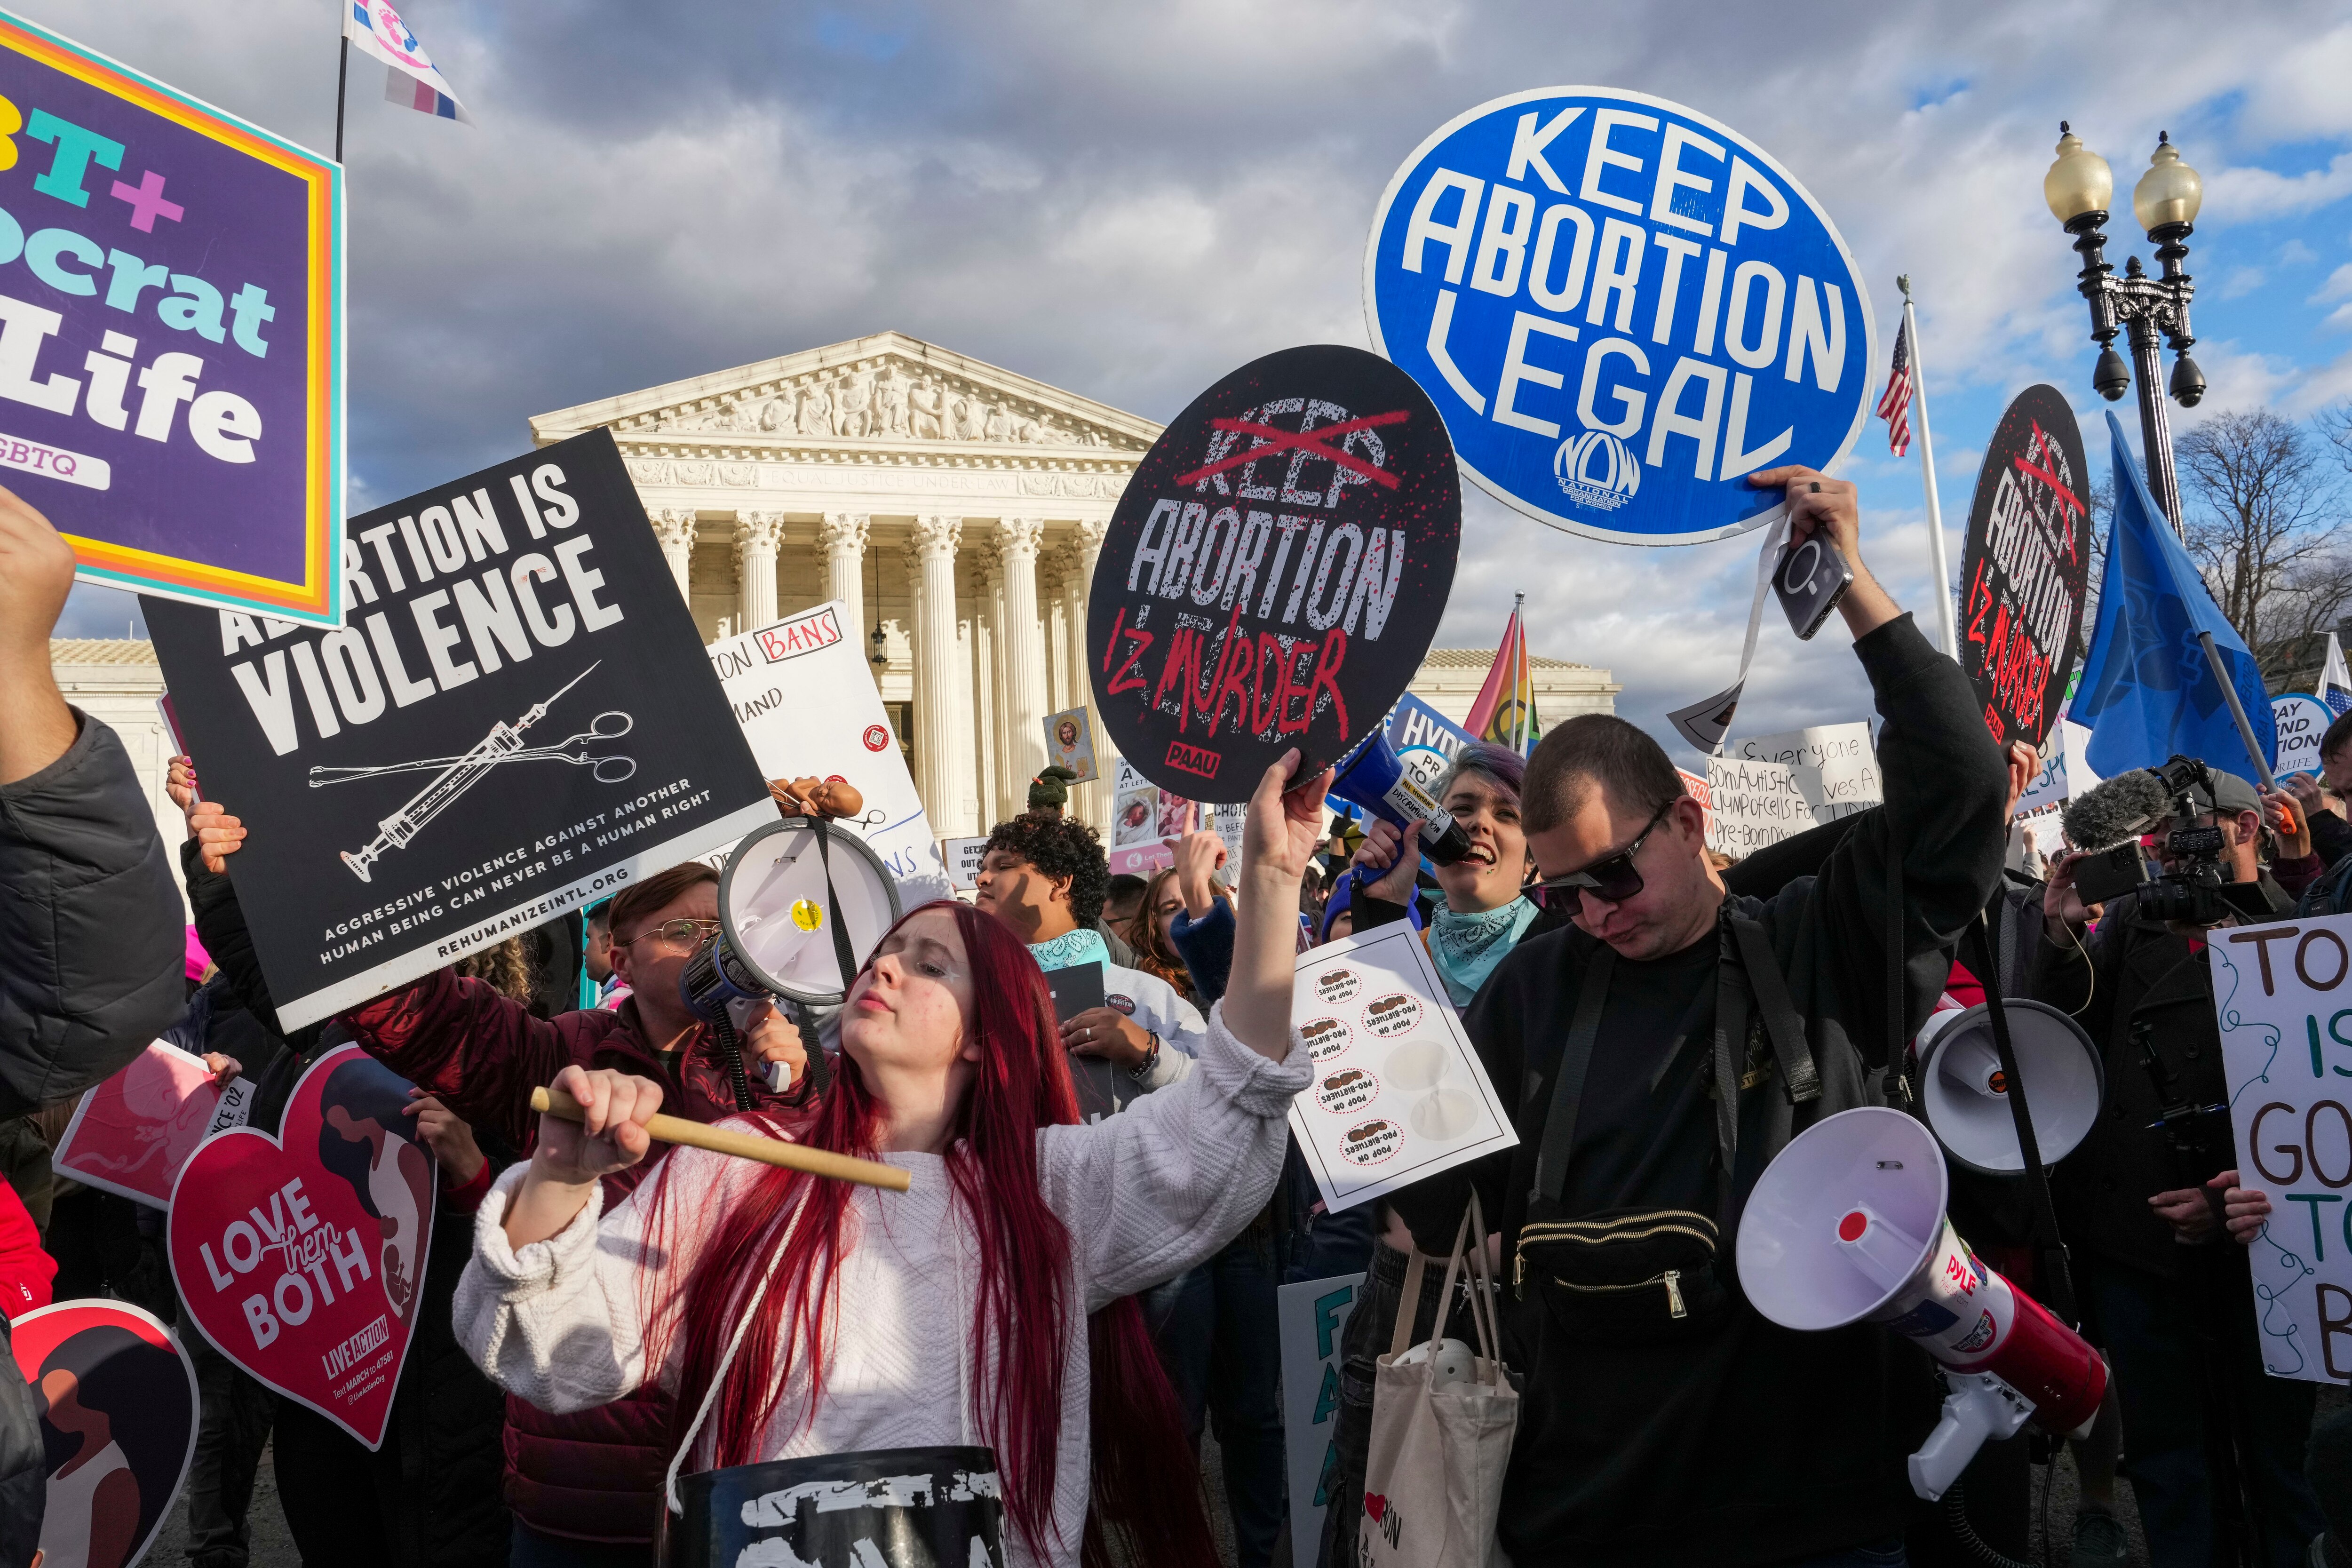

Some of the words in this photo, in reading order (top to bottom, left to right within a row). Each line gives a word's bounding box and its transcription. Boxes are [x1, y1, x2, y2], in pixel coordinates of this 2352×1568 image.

[1506, 107, 1789, 246] KEEP
[1401, 167, 1845, 393] ABORTION
[1426, 288, 1794, 482] LEGAL
[1196, 398, 1385, 508] KEEP
[1554, 431, 1640, 496] NOW
[772, 471, 833, 485] EQUAL
[841, 473, 904, 487] JUSTICE
[914, 475, 969, 489] UNDER
[977, 477, 1009, 490] LAW
[1558, 478, 1628, 502] NATIONAL
[2021, 431, 2077, 558] KEEP
[509, 463, 579, 540] IS
[1563, 487, 1621, 507] ORGANIZATION
[1585, 498, 1613, 509] WOMEN
[1128, 498, 1406, 640] ABORTION
[1986, 467, 2072, 676] ABORTION
[231, 533, 624, 756] VIOLENCE
[711, 642, 752, 682] ON
[762, 614, 836, 659] BANS
[1154, 603, 1348, 741] MURDER
[1985, 605, 2050, 742] MURDER
[1986, 708, 2004, 740] PAAU
[1168, 745, 1218, 774] PAAU
[1744, 740, 1859, 769] Everyone
[1121, 768, 1132, 781] A
[1409, 762, 1427, 784] TO
[1862, 768, 1875, 790] A
[1404, 791, 1418, 804] ANYTHING
[1796, 801, 1820, 819] For
[326, 886, 435, 940] AGGRESSIVE
[442, 848, 527, 890] VIOLENCE
[535, 813, 605, 852] AGAINST
[615, 779, 691, 819] ANOTHER
[961, 859, 975, 868] OUT
[320, 930, 384, 964] HUMAN
[390, 905, 443, 935] BEING
[450, 887, 485, 909] CAN
[491, 861, 547, 892] NEVER
[552, 850, 573, 866] BE
[582, 843, 591, 854] A
[596, 814, 657, 846] HUMAN
[661, 789, 710, 819] RIGHT
[437, 868, 628, 958] REHUMANIZEINTL.ORG
[2228, 926, 2349, 996] TO
[1110, 998, 1133, 1008] ABORTION
[1339, 989, 1352, 998] POOP
[1378, 1027, 1389, 1035] ON
[1392, 1018, 1411, 1031] POOP
[1322, 1043, 1341, 1055] POOP
[224, 1087, 244, 1106] '02
[1334, 1103, 1344, 1112] ON
[1348, 1094, 1367, 1106] POOP
[1358, 1154, 1369, 1163] ON
[1372, 1145, 1391, 1158] POOP
[199, 1177, 319, 1293] LOVE
[260, 1222, 342, 1274] them
[242, 1227, 372, 1350] BOTH
[322, 1340, 354, 1380] LIVE
[353, 1317, 388, 1362] ACTION
[333, 1386, 346, 1400] Text
[346, 1368, 369, 1391] MARCH
[369, 1366, 376, 1375] to
[377, 1350, 393, 1369] 47581
[354, 1375, 385, 1401] LiveActionOrg
